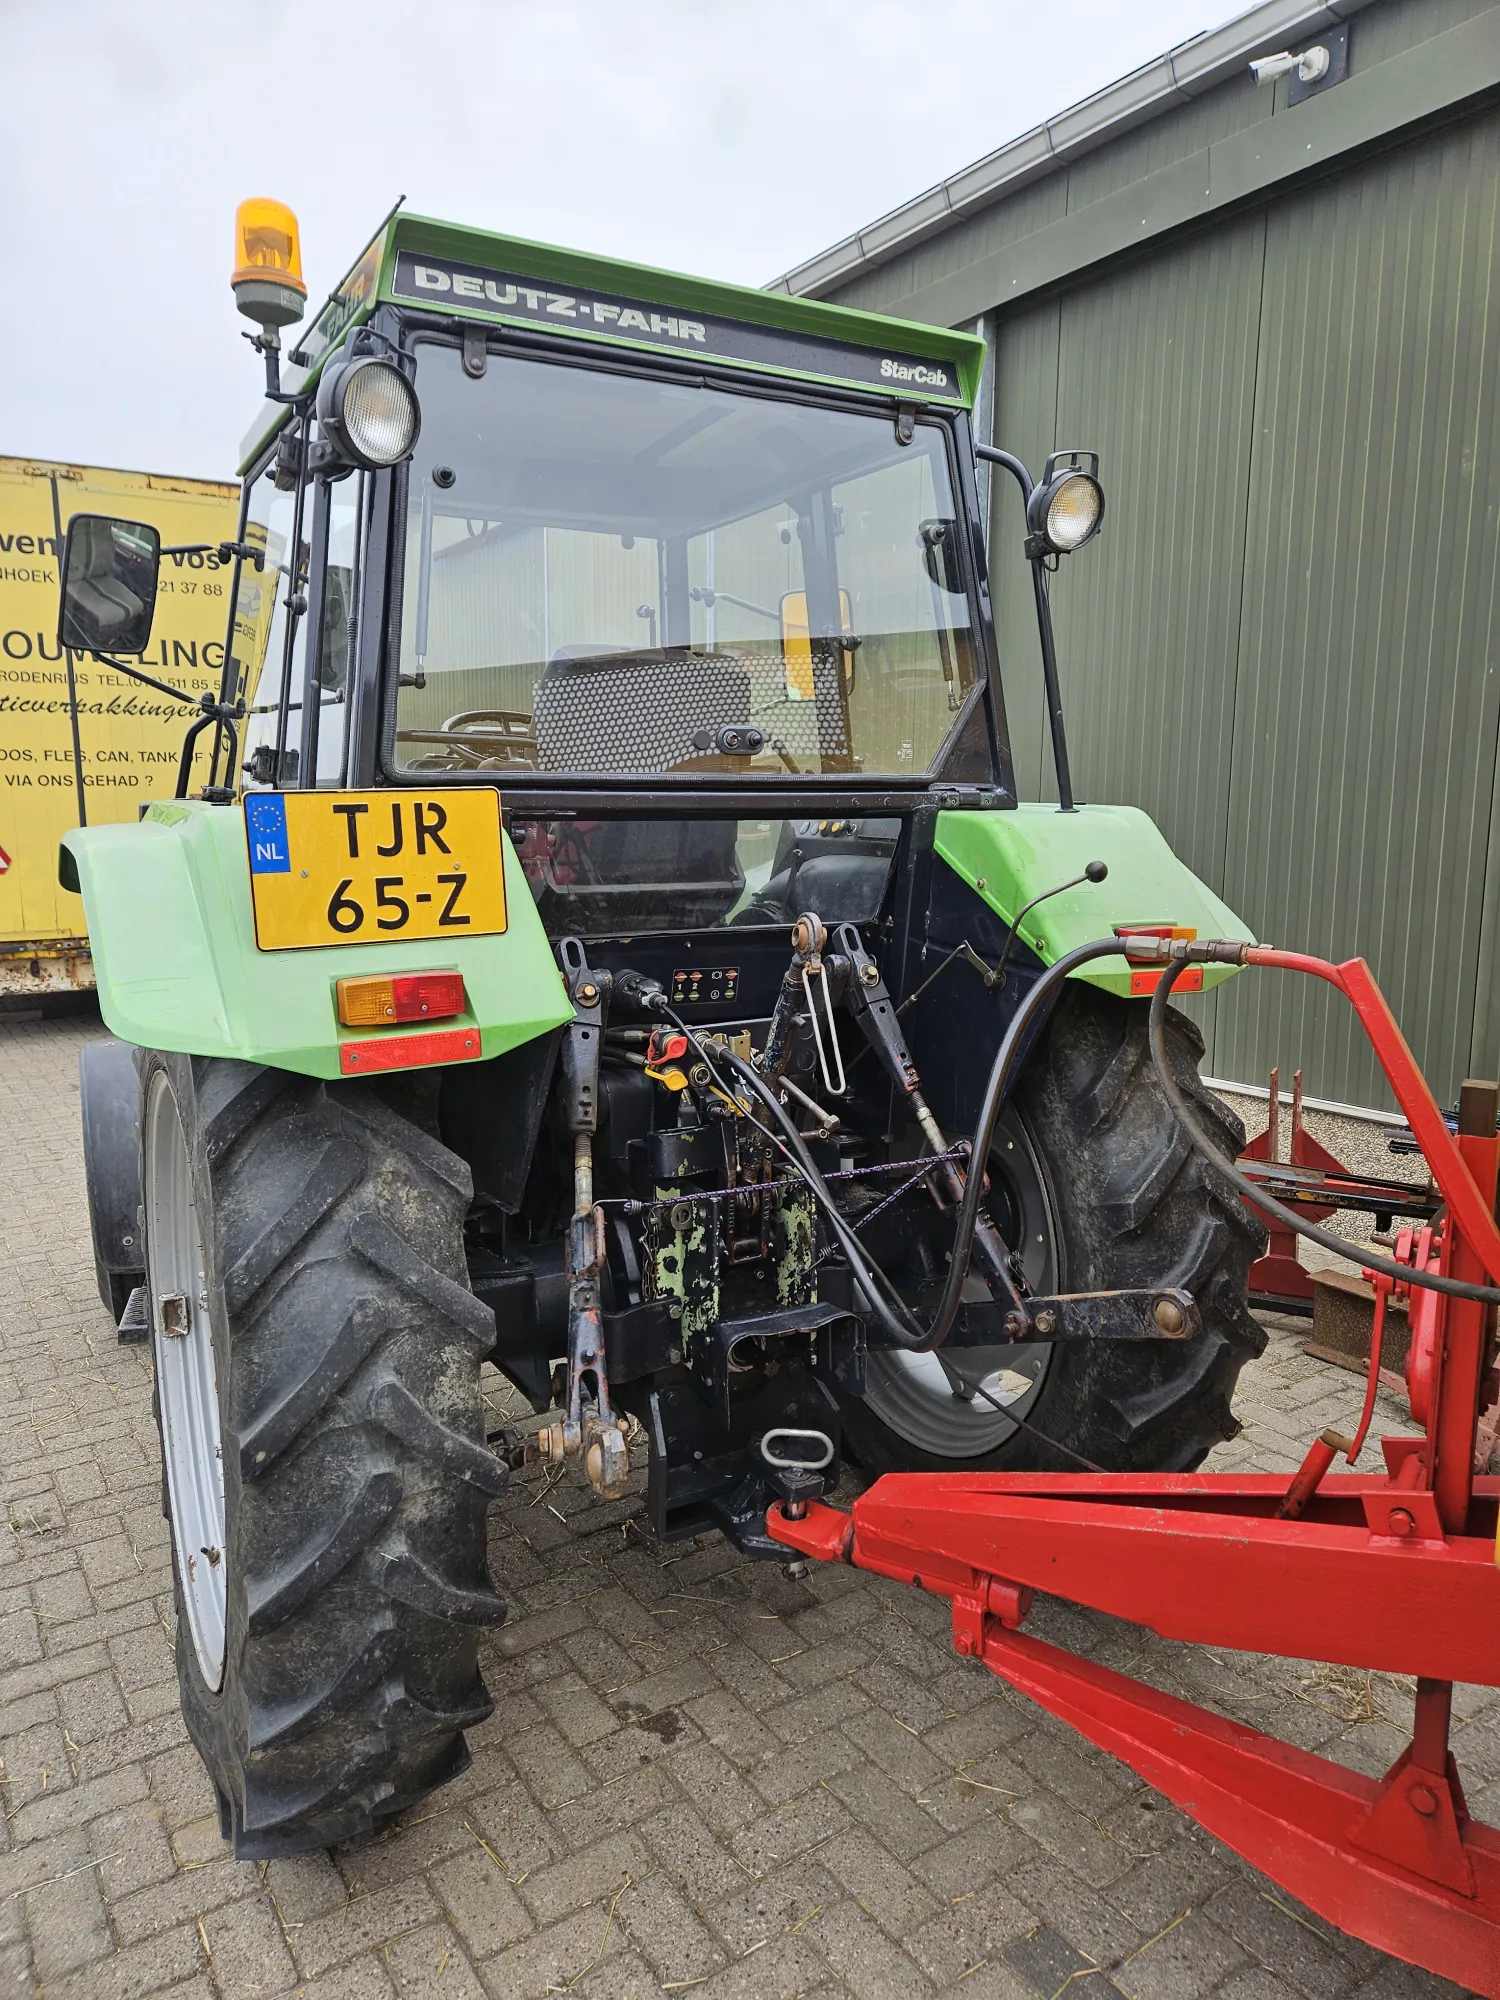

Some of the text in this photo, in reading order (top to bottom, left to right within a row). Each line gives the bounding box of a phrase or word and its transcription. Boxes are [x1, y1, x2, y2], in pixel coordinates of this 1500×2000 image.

[414, 264, 707, 342] DEUTZ-FAHR
[880, 359, 948, 387] StarCab
[0, 565, 223, 596] HOEK 21 37 88
[3, 630, 225, 669] OULING
[168, 677, 187, 688] 511
[191, 679, 209, 690] 85
[44, 750, 91, 763] FLES,
[96, 750, 134, 764] CAN,
[137, 751, 179, 763] TANK
[5, 774, 154, 787] VIA ONS GEHAD ?
[332, 801, 452, 858] TJR
[255, 843, 285, 861] NL
[327, 873, 471, 934] 65-Z
